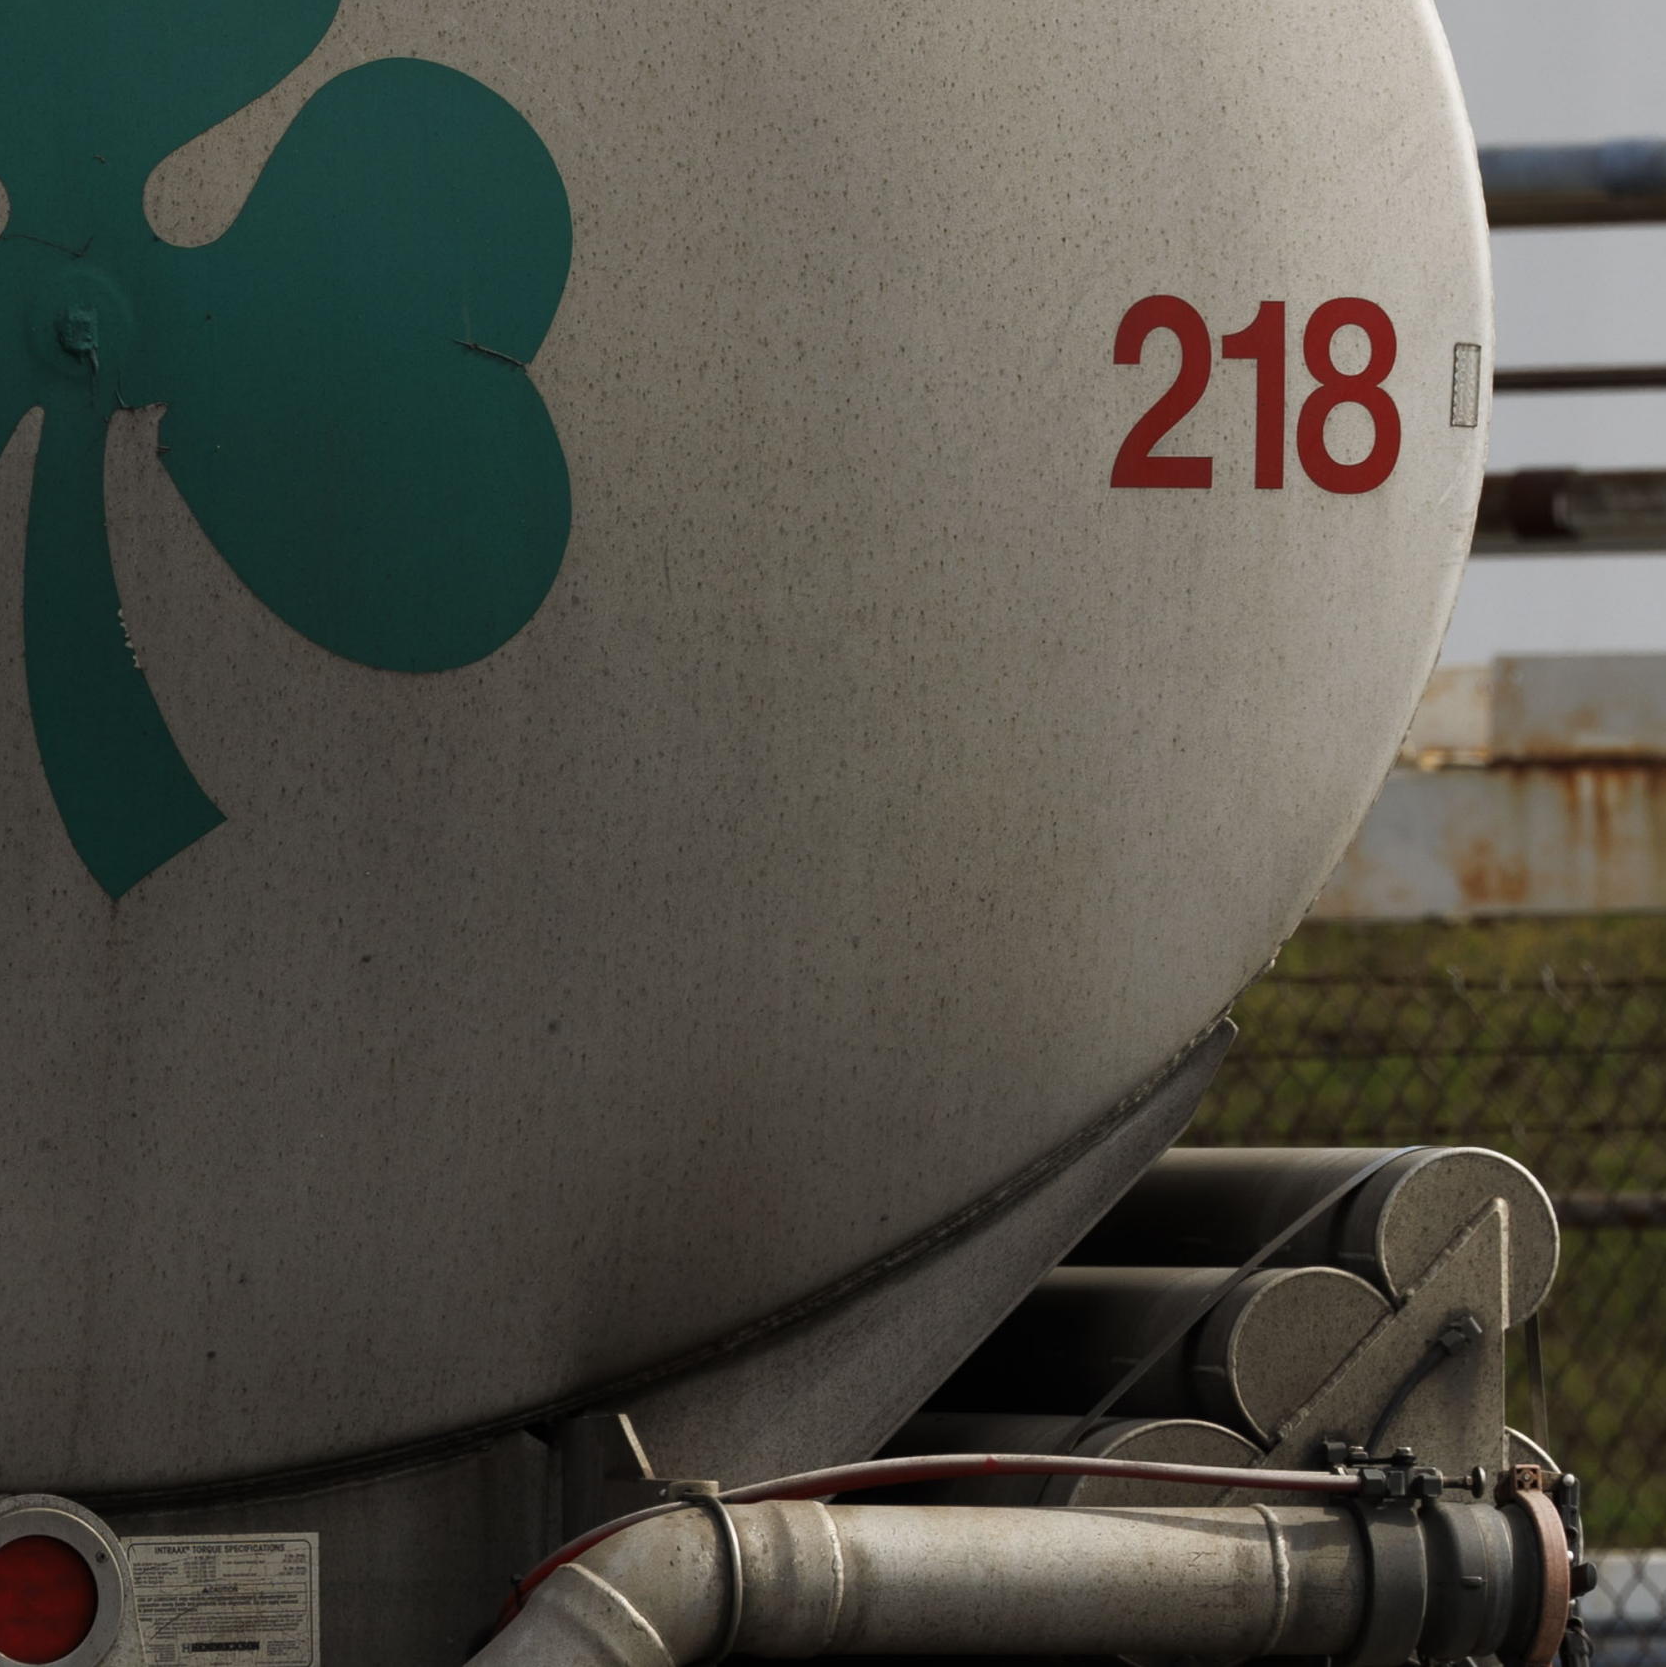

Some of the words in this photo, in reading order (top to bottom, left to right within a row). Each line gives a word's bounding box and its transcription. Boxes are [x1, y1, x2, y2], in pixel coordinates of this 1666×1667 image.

[1110, 294, 1402, 495] 218
[192, 1545, 222, 1554] TORQUE
[224, 1544, 285, 1554] SPECIFICATIONS
